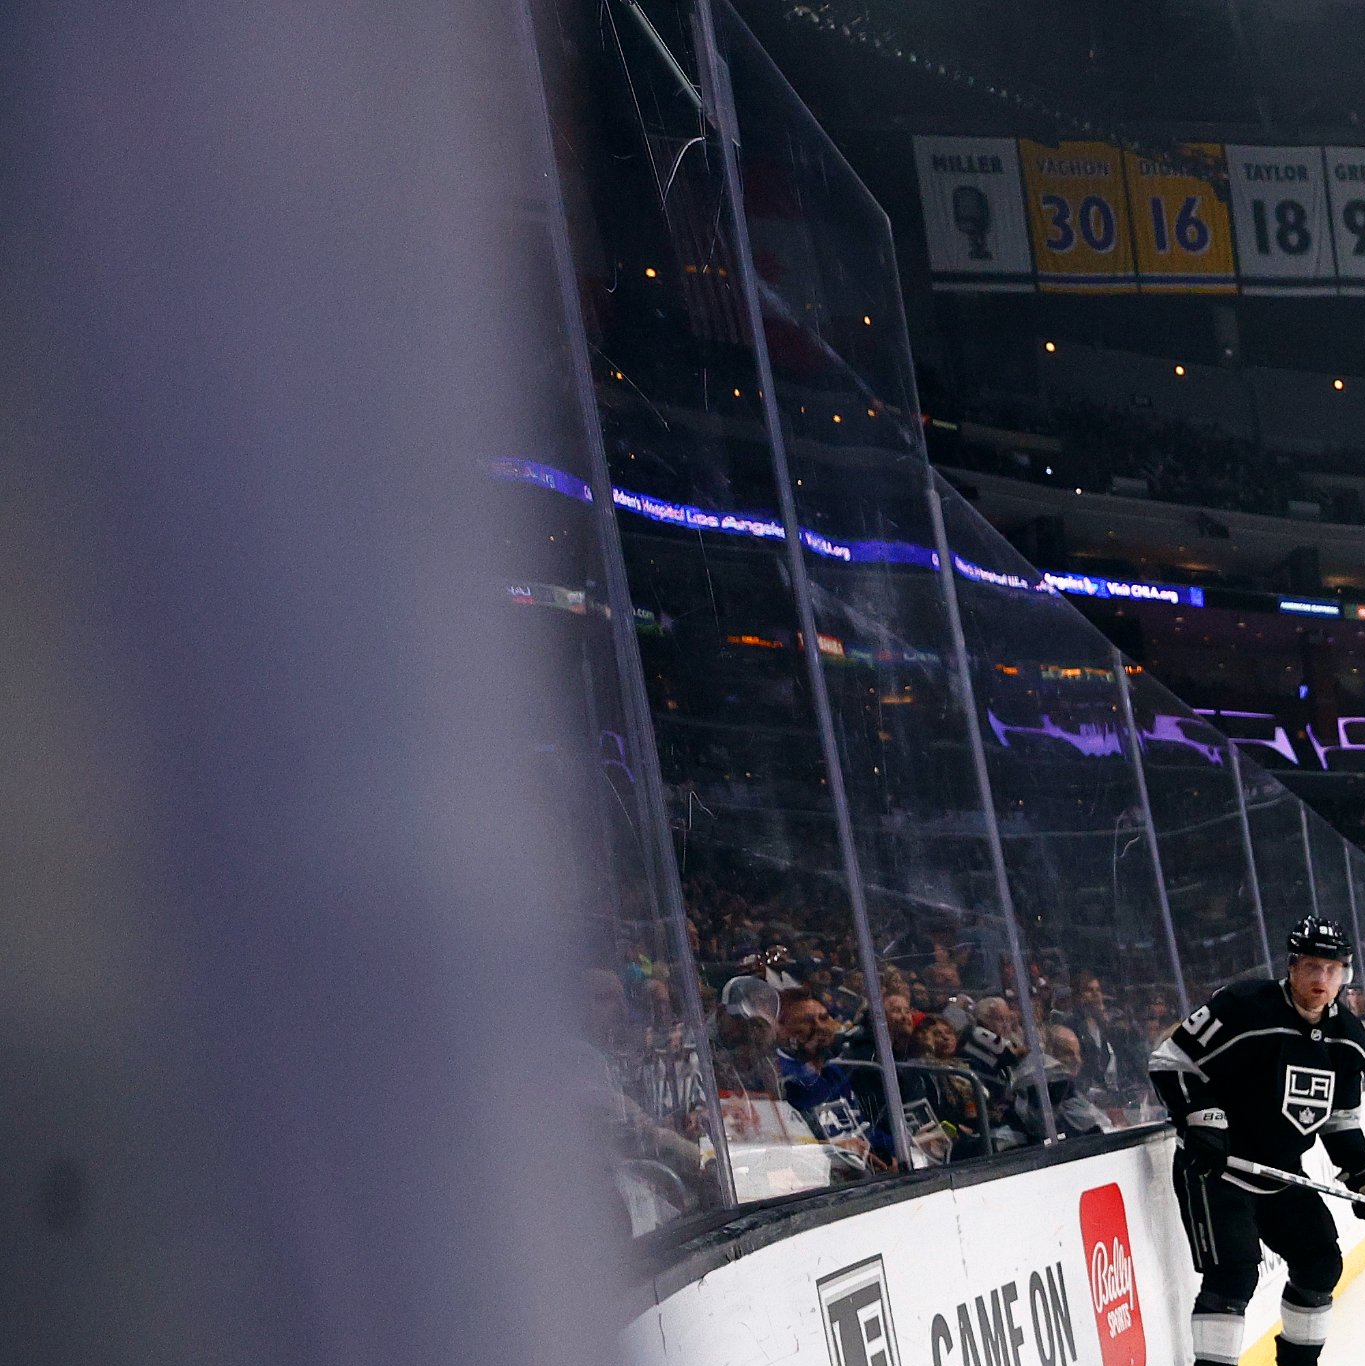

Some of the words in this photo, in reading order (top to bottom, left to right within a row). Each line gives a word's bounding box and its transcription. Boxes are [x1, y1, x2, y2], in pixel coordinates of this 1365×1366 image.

[931, 154, 1003, 174] MILLER
[1244, 163, 1307, 182] TAYLOR
[1041, 194, 1116, 254] 30
[1150, 196, 1211, 254] 16
[1253, 200, 1312, 257] 18
[1290, 1072, 1330, 1098] LA
[1091, 1236, 1132, 1314] Bally
[1106, 1303, 1132, 1339] SPORTS
